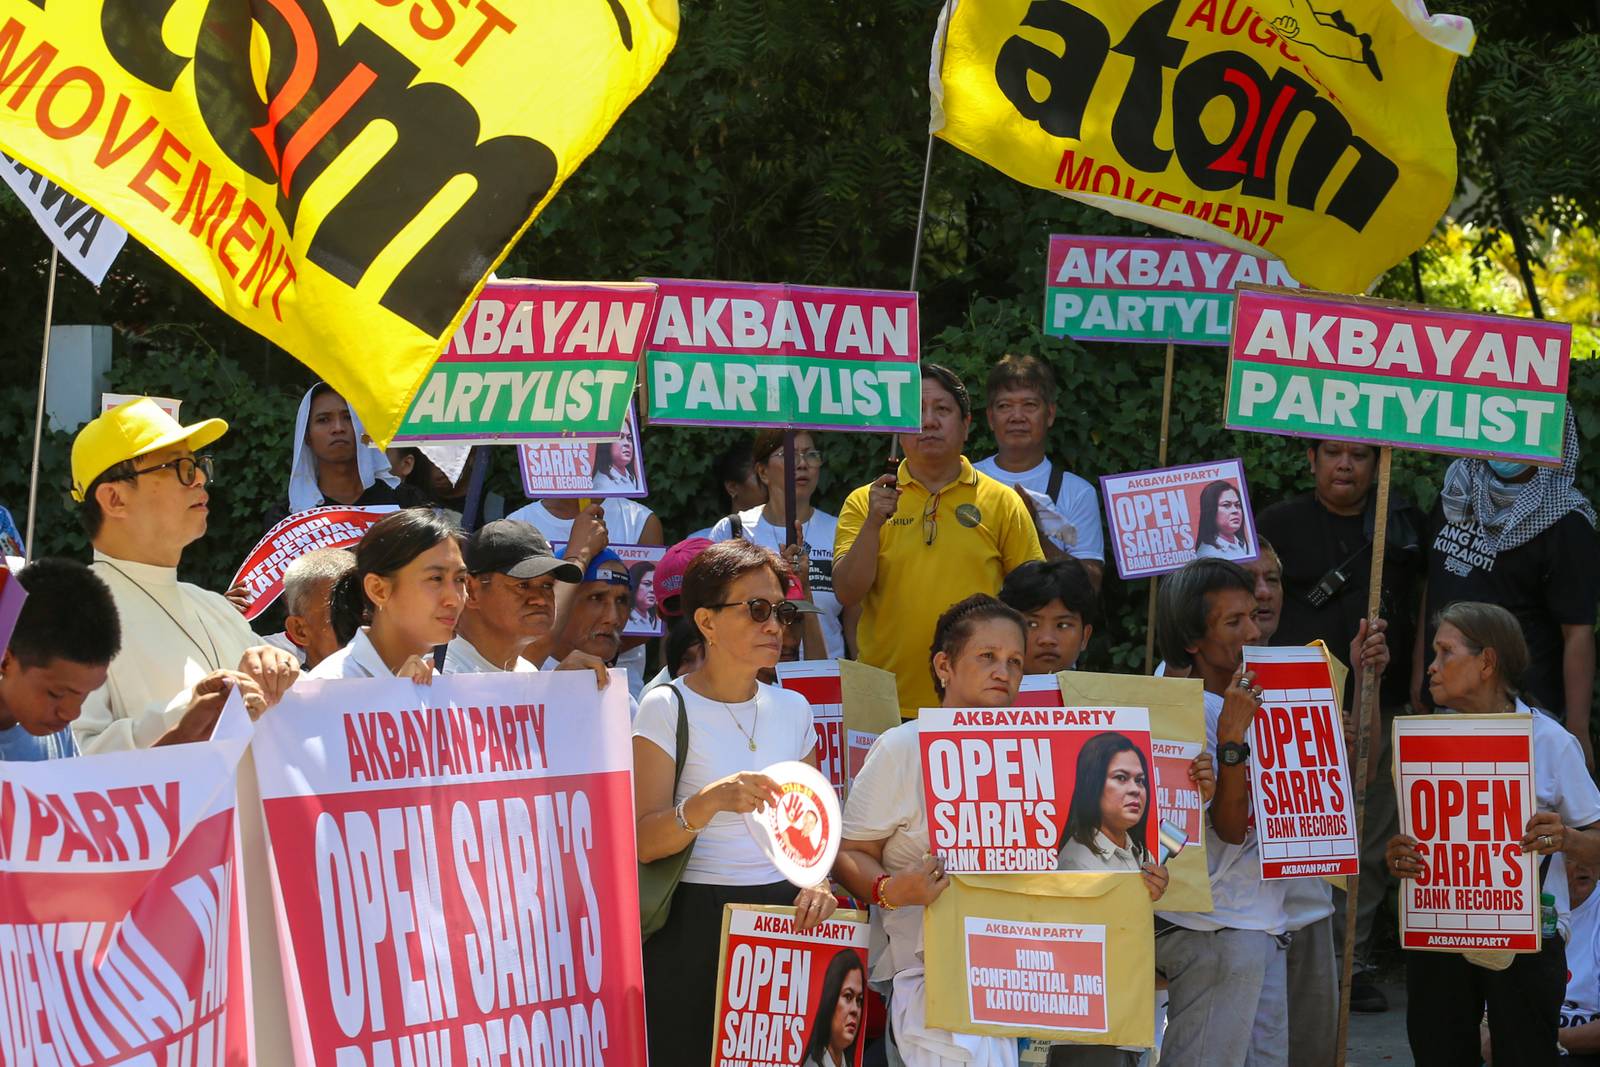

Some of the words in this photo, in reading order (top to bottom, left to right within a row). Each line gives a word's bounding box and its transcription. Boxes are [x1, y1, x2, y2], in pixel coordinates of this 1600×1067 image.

[375, 0, 518, 68] ST
[995, 0, 1399, 233] atom
[0, 17, 299, 322] MOVEMENT
[441, 299, 646, 355] KBAYAN
[651, 295, 910, 357] AKBAYAN
[1052, 293, 1234, 335] PARTYL
[1244, 308, 1562, 388] AKBAYAN
[408, 368, 627, 424] ARTYLIST
[653, 360, 913, 418] PARTYLIST
[1237, 370, 1556, 447] PARTYLIST
[1127, 474, 1183, 490] AKBAYAN
[1183, 468, 1220, 481] PARTY
[1115, 489, 1191, 532] OPEN
[242, 520, 361, 586] NFIDENTIAL
[271, 516, 333, 551] HINDI
[616, 549, 649, 559] PARTY
[1122, 524, 1195, 558] SARA'S
[1433, 536, 1495, 572] KURAKOT!
[1438, 523, 1471, 546] ANG
[1127, 553, 1153, 570] BANK
[1155, 549, 1198, 566] RECORDS
[953, 710, 1049, 726] AKBAYAN
[1053, 710, 1116, 726] PARTY
[1254, 705, 1339, 770] OPEN
[343, 706, 475, 783] AKBAYAN
[467, 704, 548, 774] PARTY
[1152, 743, 1184, 755] PARTY
[928, 738, 1056, 801] OPEN
[1175, 788, 1200, 810] ANG
[1260, 768, 1344, 816] SARA'S
[1410, 779, 1523, 842] OPEN
[21, 781, 180, 862] PARTY
[933, 801, 1058, 848] SARA'S
[1266, 817, 1297, 839] BANK
[1299, 814, 1347, 838] RECORDS
[937, 848, 981, 871] BANK
[985, 848, 1058, 871] RECORDS
[1281, 864, 1316, 876] AKBAYAN
[1316, 862, 1341, 874] PARTY
[314, 804, 459, 1038] OPEN
[451, 790, 603, 1014] SARA'S
[1414, 887, 1450, 910] BANK
[1455, 889, 1524, 911] RECORDS
[816, 922, 857, 941] PARTY
[985, 923, 1041, 937] AKBAYAN
[1043, 928, 1084, 939] PARTY
[1427, 936, 1475, 947] AKBAYAN
[1476, 937, 1511, 947] PARTY
[728, 943, 812, 1016] OPEN
[970, 966, 1069, 993] CONFIDENTIAL
[1074, 974, 1103, 995] ANG
[1015, 949, 1055, 971] HINDI
[985, 988, 1089, 1016] KATOTOHANAN
[722, 1010, 805, 1063] SARA'S
